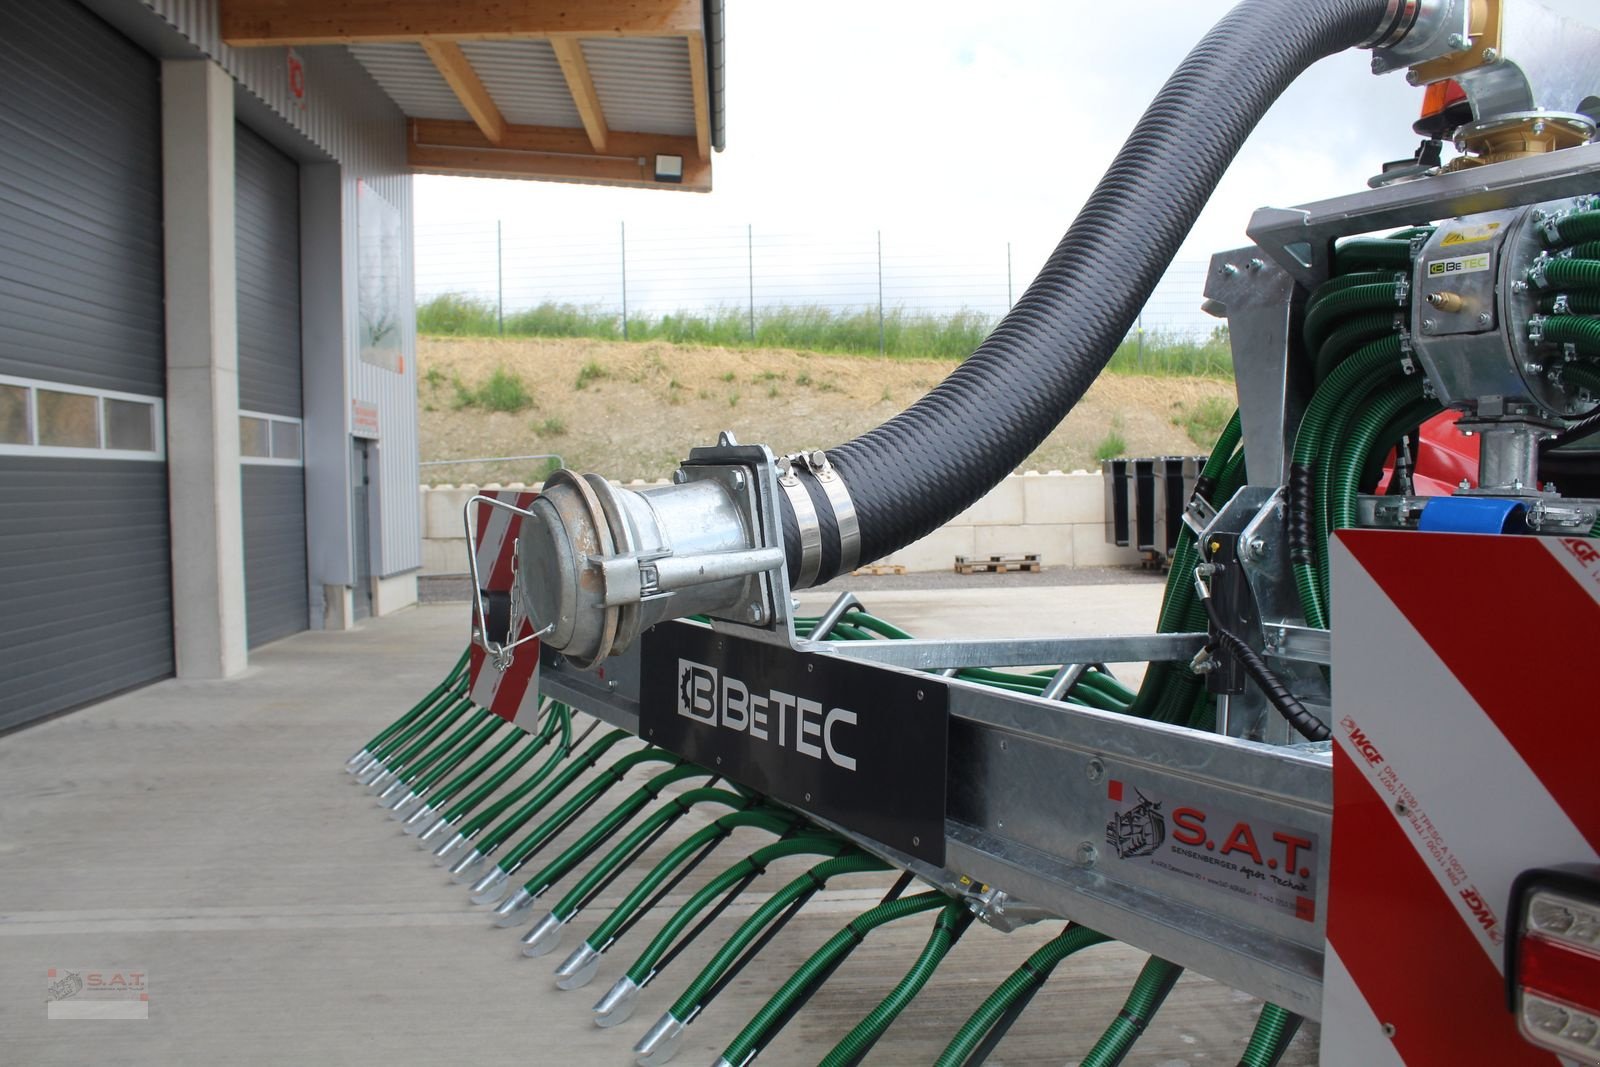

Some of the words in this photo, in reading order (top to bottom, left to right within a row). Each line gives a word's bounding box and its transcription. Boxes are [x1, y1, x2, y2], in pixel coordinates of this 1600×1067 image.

[1563, 538, 1600, 562] GF
[1349, 728, 1384, 765] WGF
[1384, 765, 1399, 783] DIN
[1398, 783, 1418, 808] 11030
[1171, 845, 1238, 871] SENSENBERGER
[1172, 806, 1311, 878] S.A.T.
[1459, 889, 1497, 930] WGF
